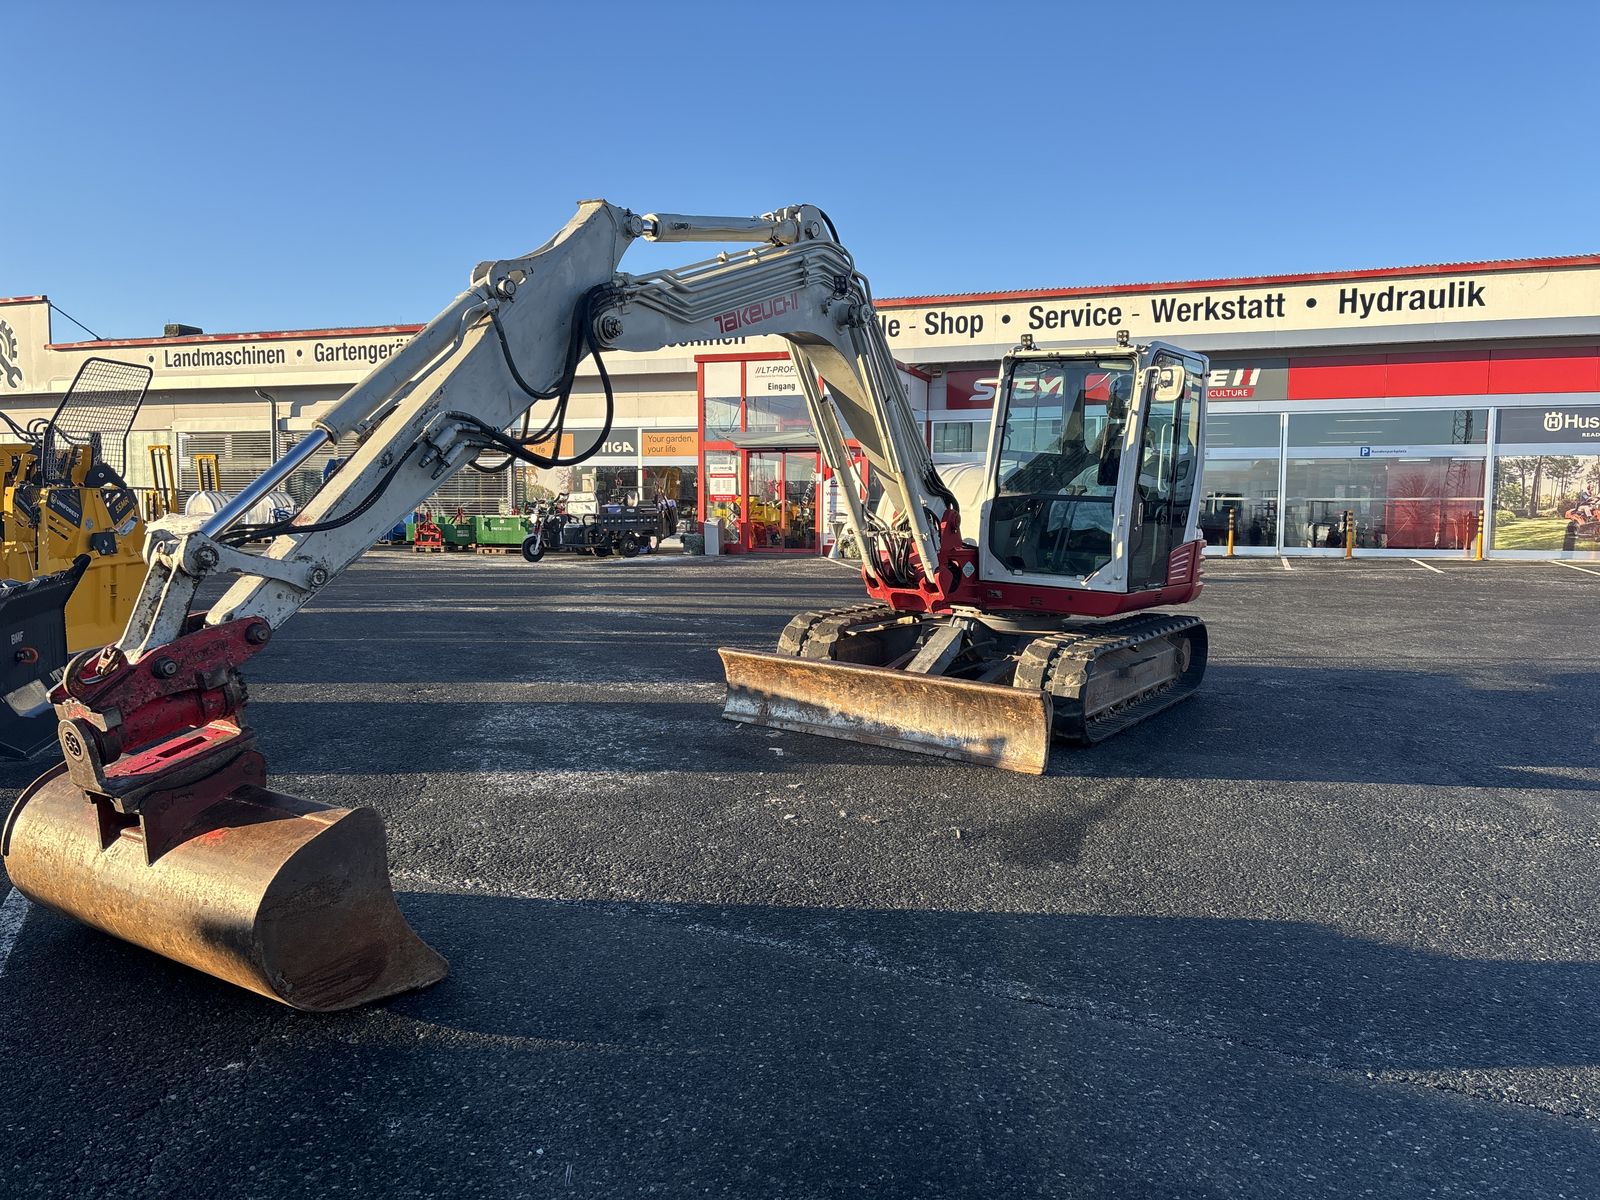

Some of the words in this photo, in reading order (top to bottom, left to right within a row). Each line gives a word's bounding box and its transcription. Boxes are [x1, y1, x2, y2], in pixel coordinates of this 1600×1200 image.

[1339, 281, 1486, 319] Hydraulik
[1028, 305, 1122, 329] Service
[1151, 293, 1286, 323] Werkstatt
[924, 311, 984, 338] Shop
[164, 348, 285, 368] Landmaschinen
[767, 382, 796, 391] Eingang
[648, 435, 665, 443] Your
[666, 434, 694, 444] garden,
[601, 442, 635, 453] TIGA
[647, 446, 663, 455] your
[665, 445, 677, 453] life
